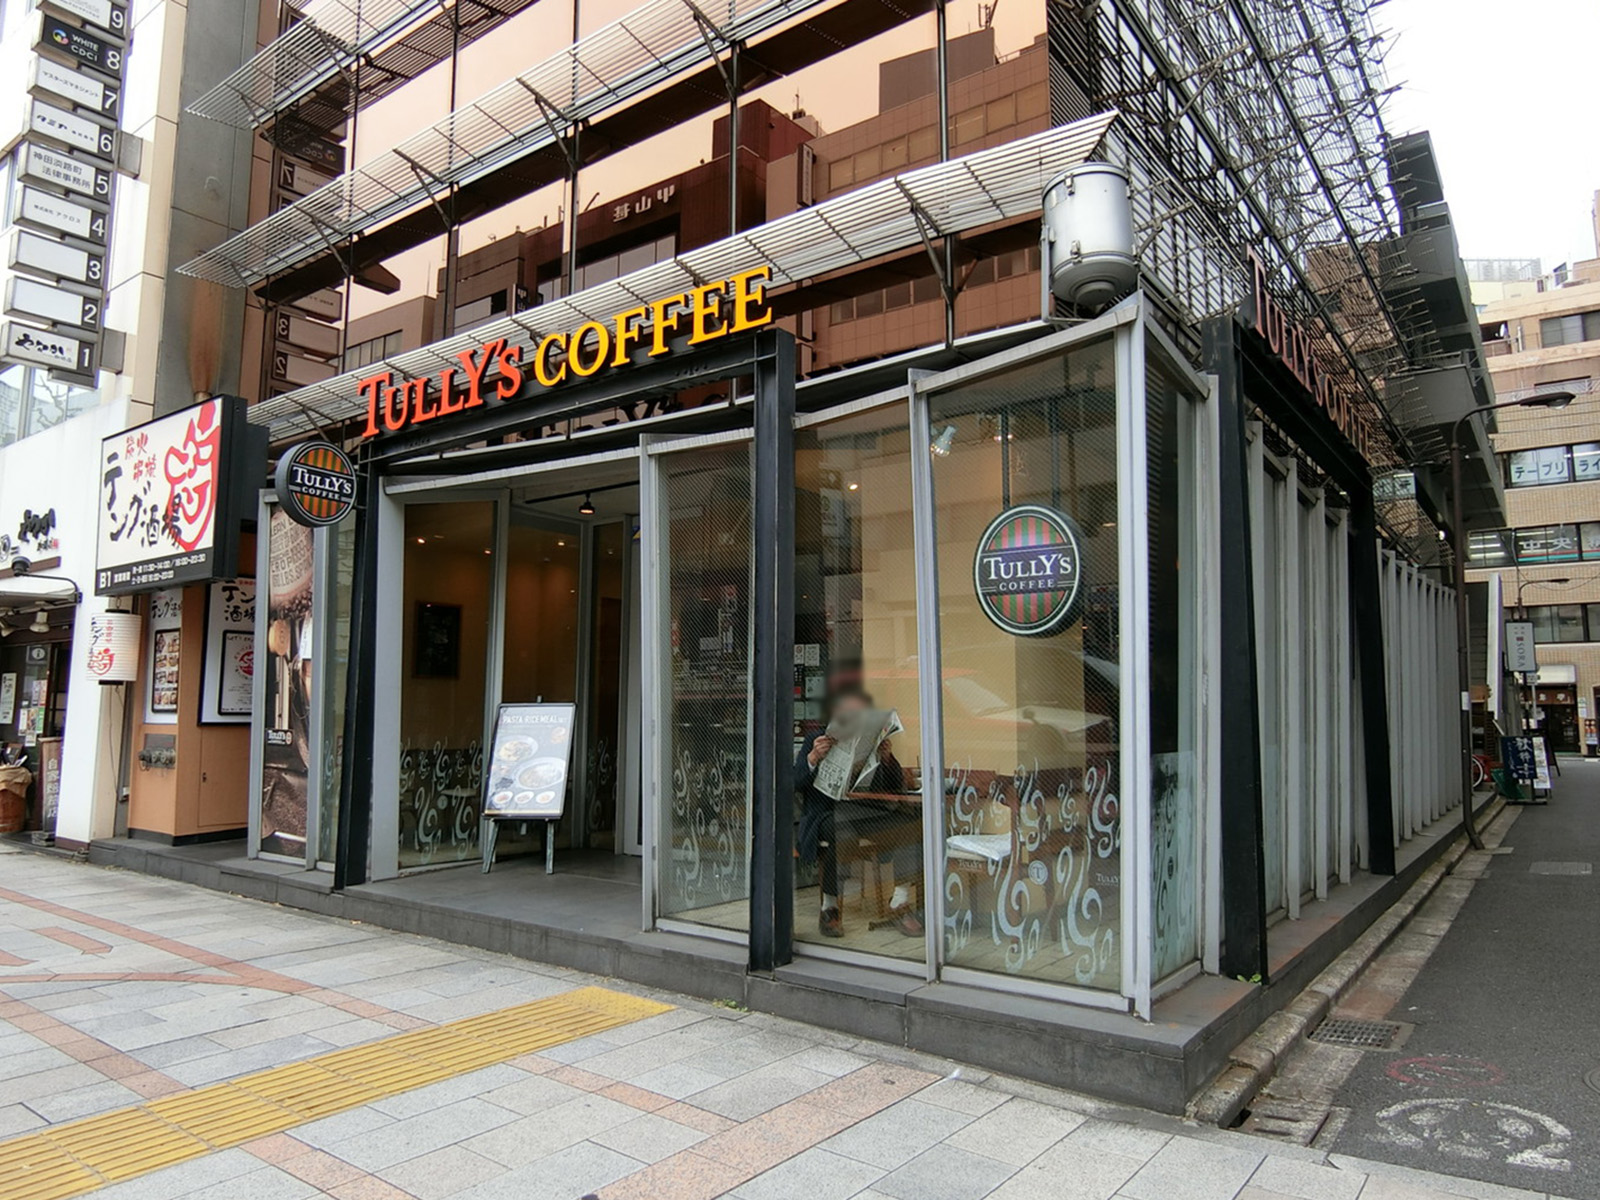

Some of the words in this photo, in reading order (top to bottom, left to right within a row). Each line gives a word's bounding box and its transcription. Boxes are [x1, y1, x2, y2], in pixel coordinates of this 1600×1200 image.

[111, 10, 124, 29] 9
[72, 34, 99, 52] WHITE
[107, 51, 120, 70] 8
[105, 91, 117, 110] 7
[100, 134, 112, 152] 6
[33, 151, 83, 175] 神田淡路町
[42, 166, 91, 189] 法律事務所
[96, 176, 108, 194] 5
[92, 218, 105, 236] 4
[88, 260, 101, 280] 3
[84, 304, 97, 324] 2
[534, 265, 773, 388] COFFEE
[83, 348, 89, 367] 1
[302, 486, 340, 500] COFFEE
[100, 571, 112, 588] B1
[999, 579, 1055, 591] COFFEE
[1516, 642, 1526, 668] SORA
